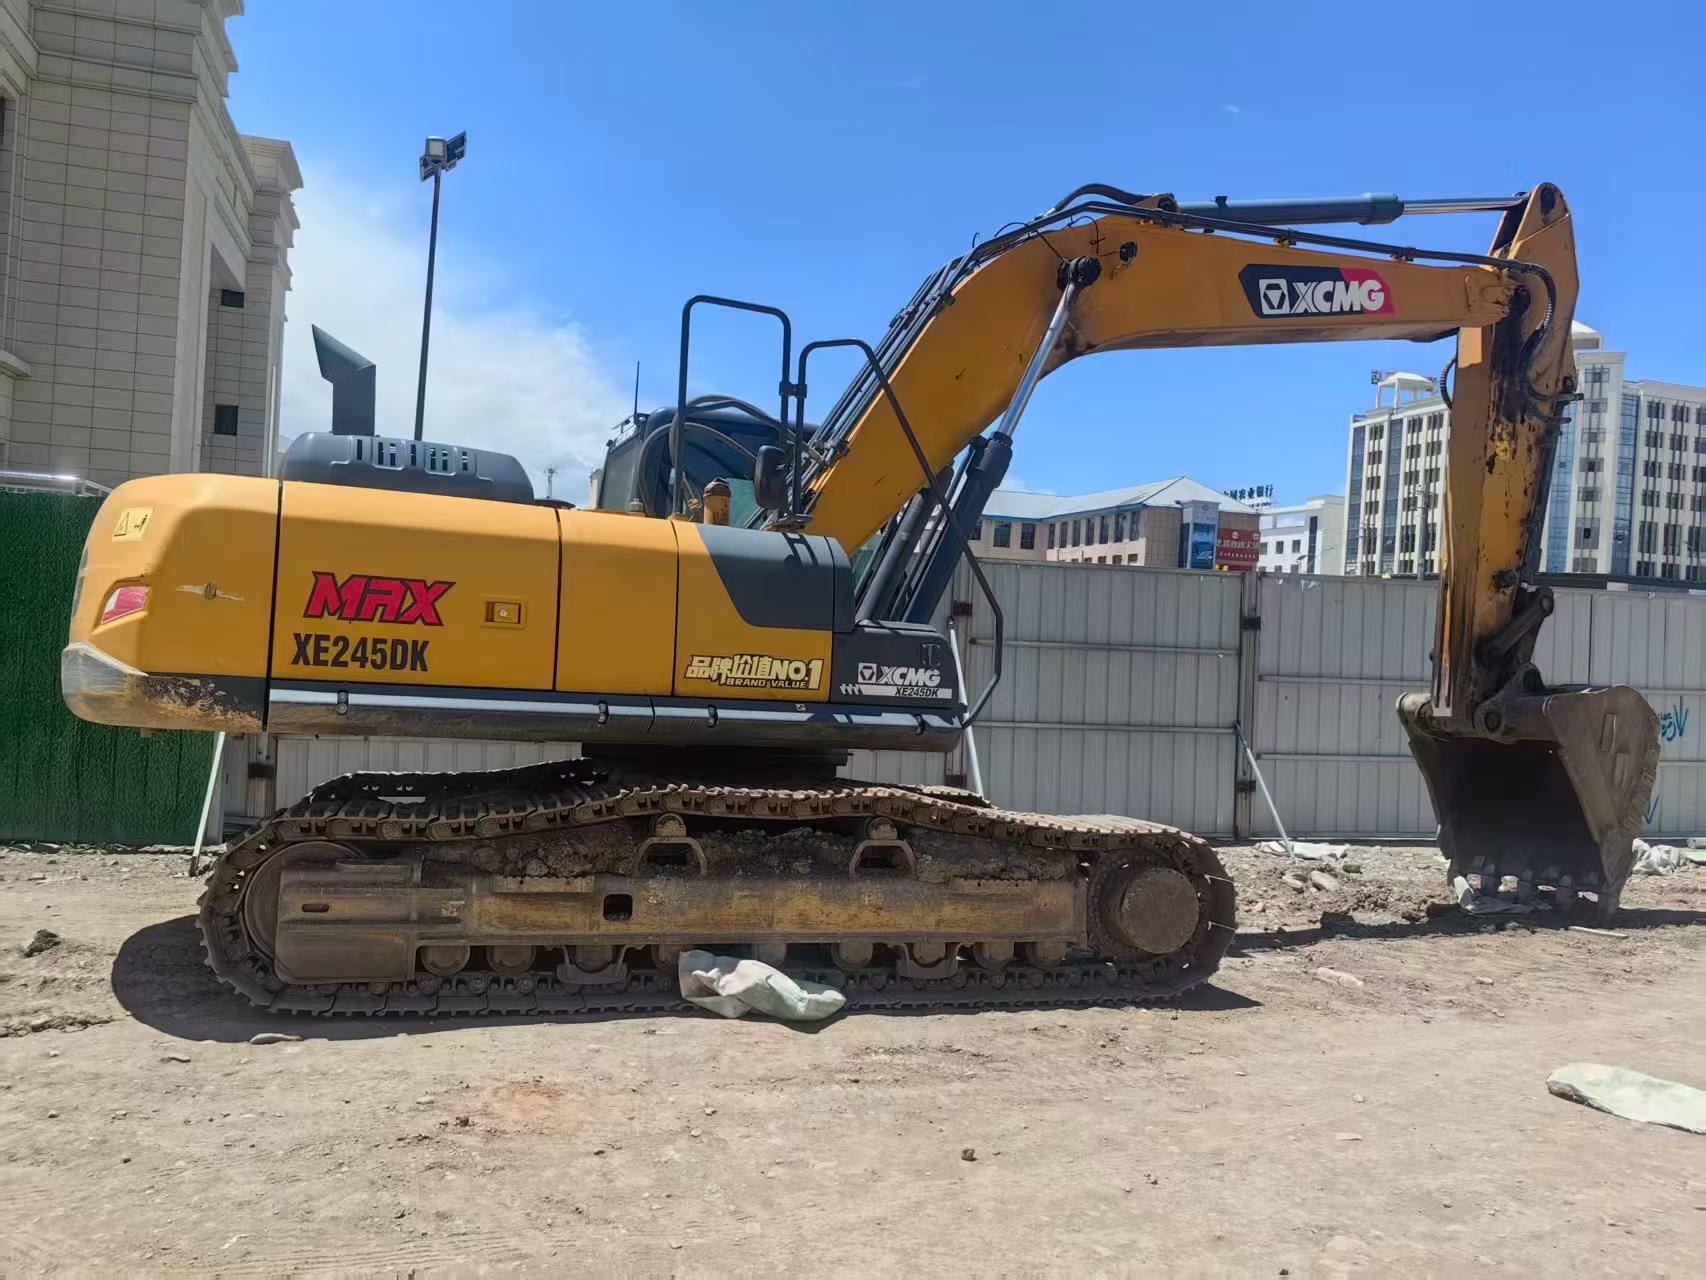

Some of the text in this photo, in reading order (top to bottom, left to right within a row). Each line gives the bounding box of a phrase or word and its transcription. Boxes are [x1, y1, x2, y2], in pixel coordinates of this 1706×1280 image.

[1290, 279, 1385, 314] XCMG
[303, 571, 456, 626] MAX
[291, 633, 430, 672] XE245DK
[726, 677, 808, 689] BRAND VALUE
[876, 666, 941, 687] XCMG
[894, 687, 940, 698] XE245DK
